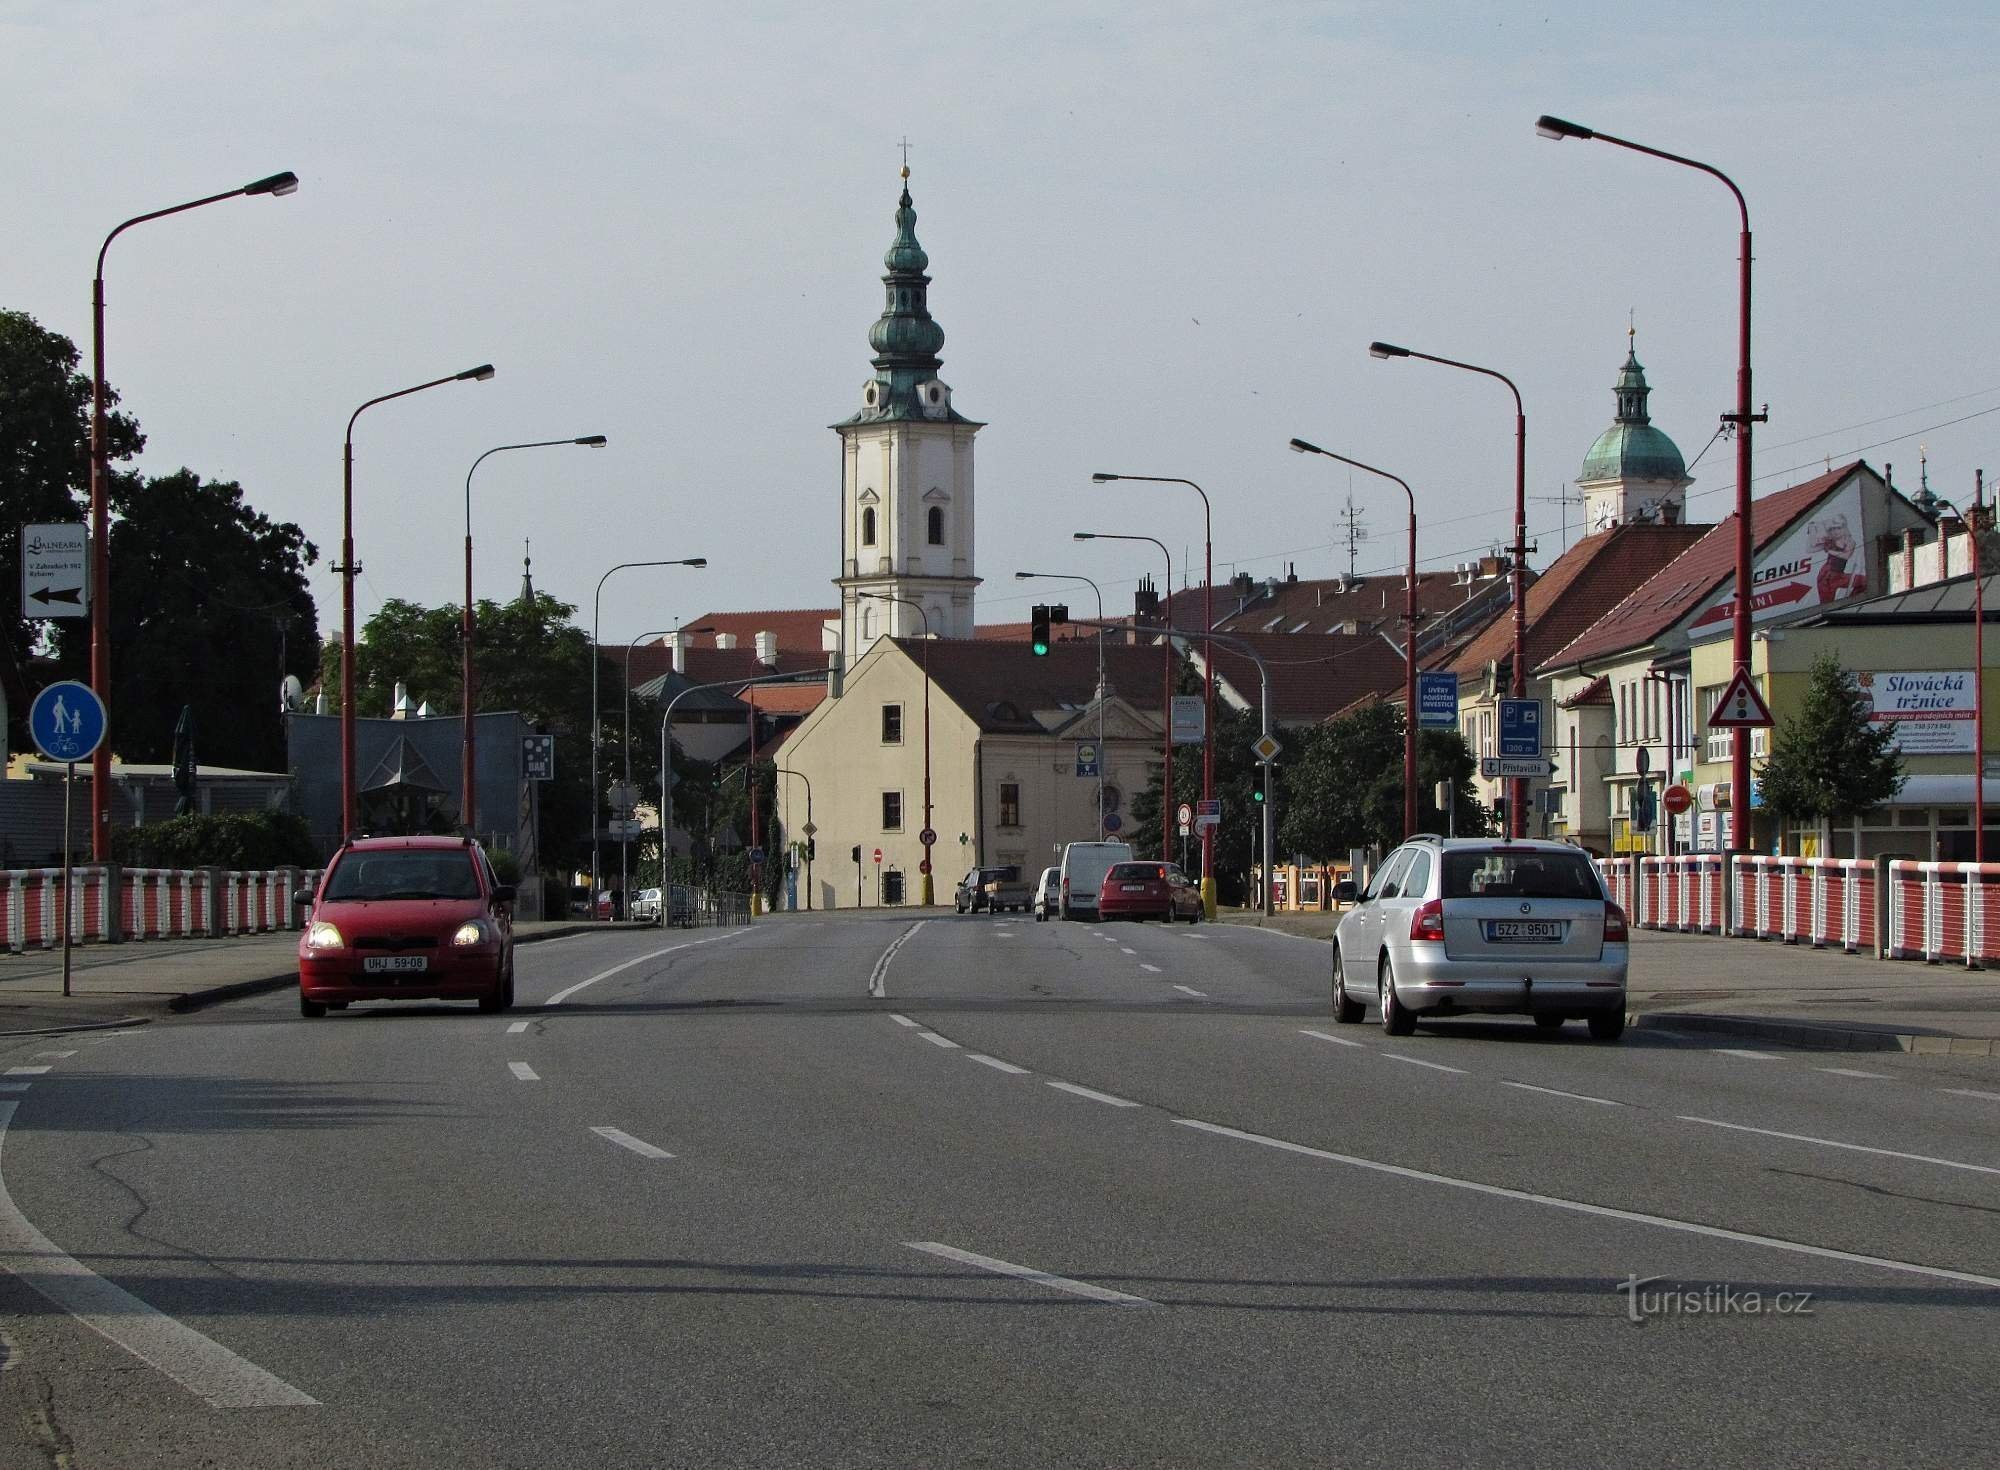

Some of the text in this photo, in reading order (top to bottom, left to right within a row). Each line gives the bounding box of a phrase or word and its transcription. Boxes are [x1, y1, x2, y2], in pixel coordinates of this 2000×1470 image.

[1753, 557, 1812, 584] CANIS
[1886, 675, 1964, 692] Slovácká
[1896, 692, 1955, 709] tržnice
[1507, 744, 1523, 752] 1300
[1498, 923, 1556, 936] 5Z2 9501
[368, 958, 388, 969] UHJ
